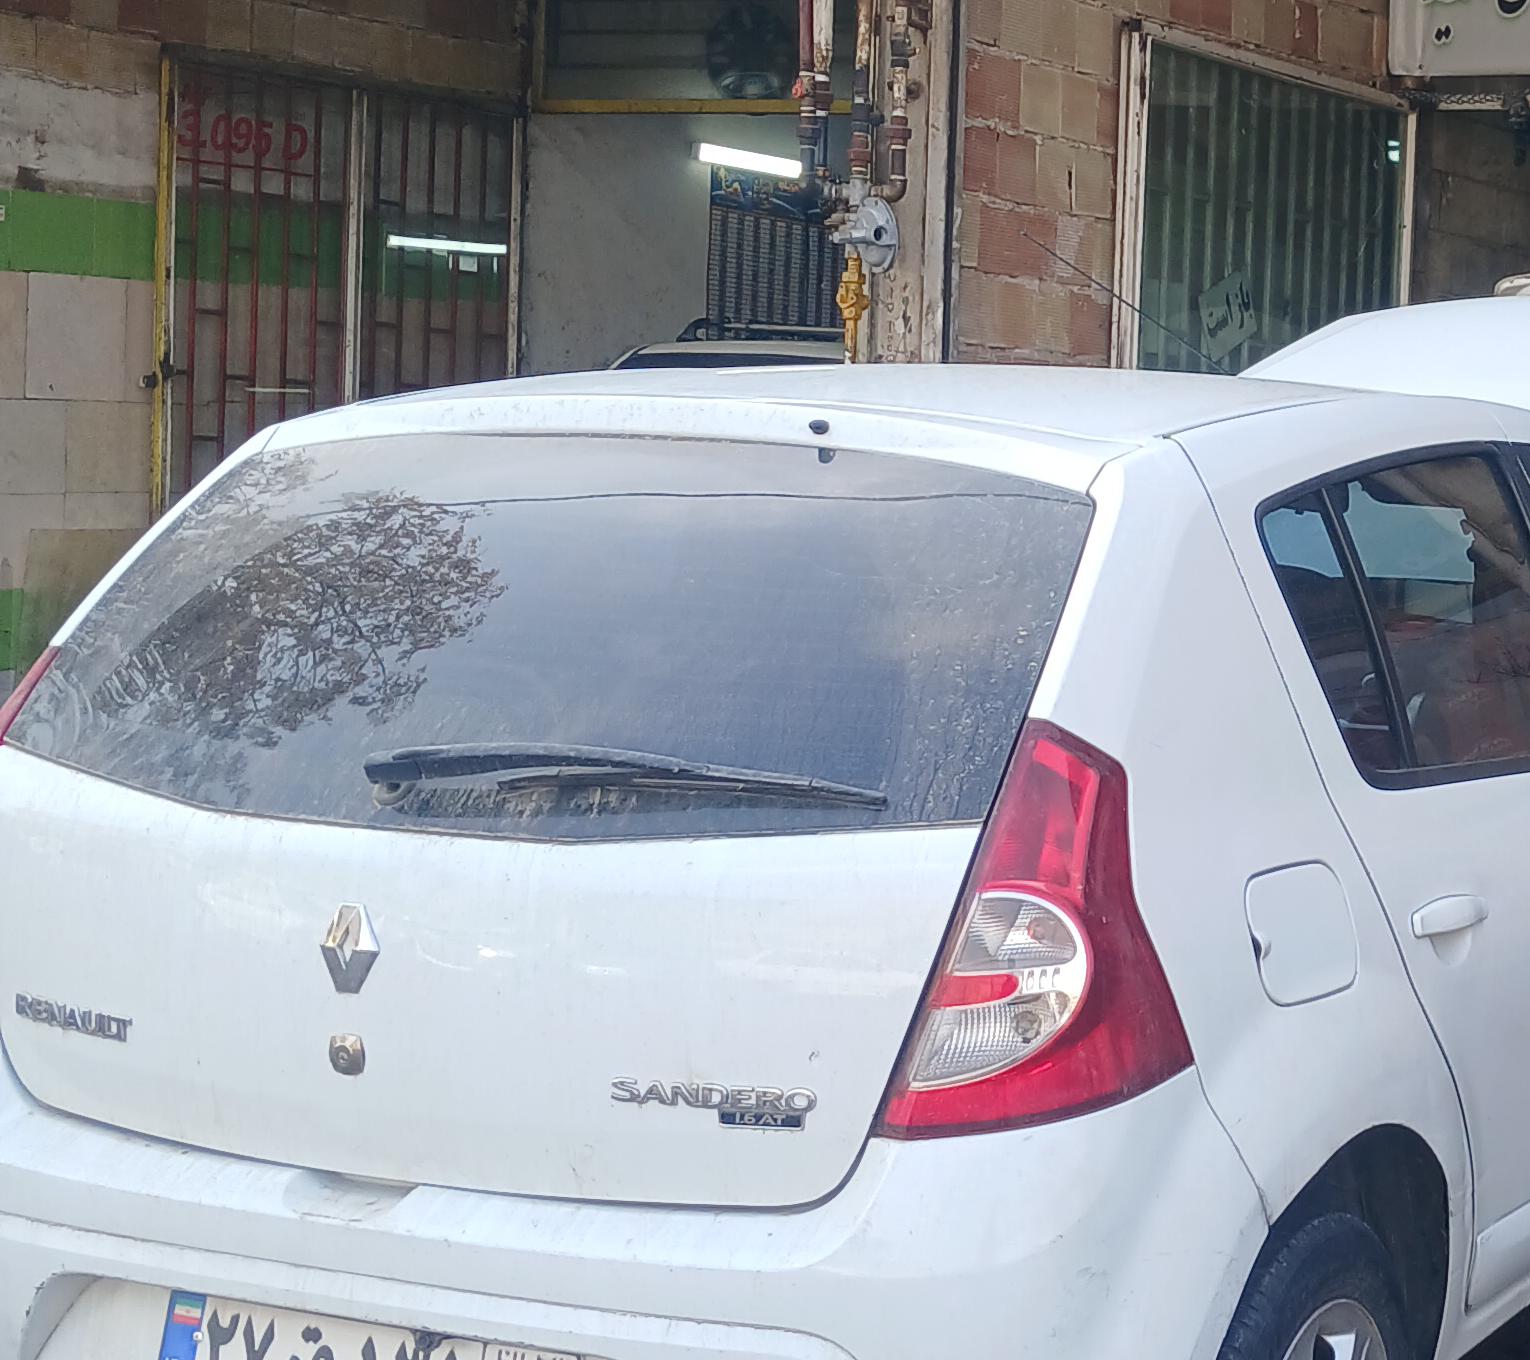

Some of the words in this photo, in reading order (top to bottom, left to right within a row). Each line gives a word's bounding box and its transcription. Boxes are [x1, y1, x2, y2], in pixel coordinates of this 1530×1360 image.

[1206, 292, 1233, 338] است
[1235, 280, 1253, 330] باز
[15, 992, 133, 1043] RENAULT
[610, 1076, 818, 1113] SANDERO
